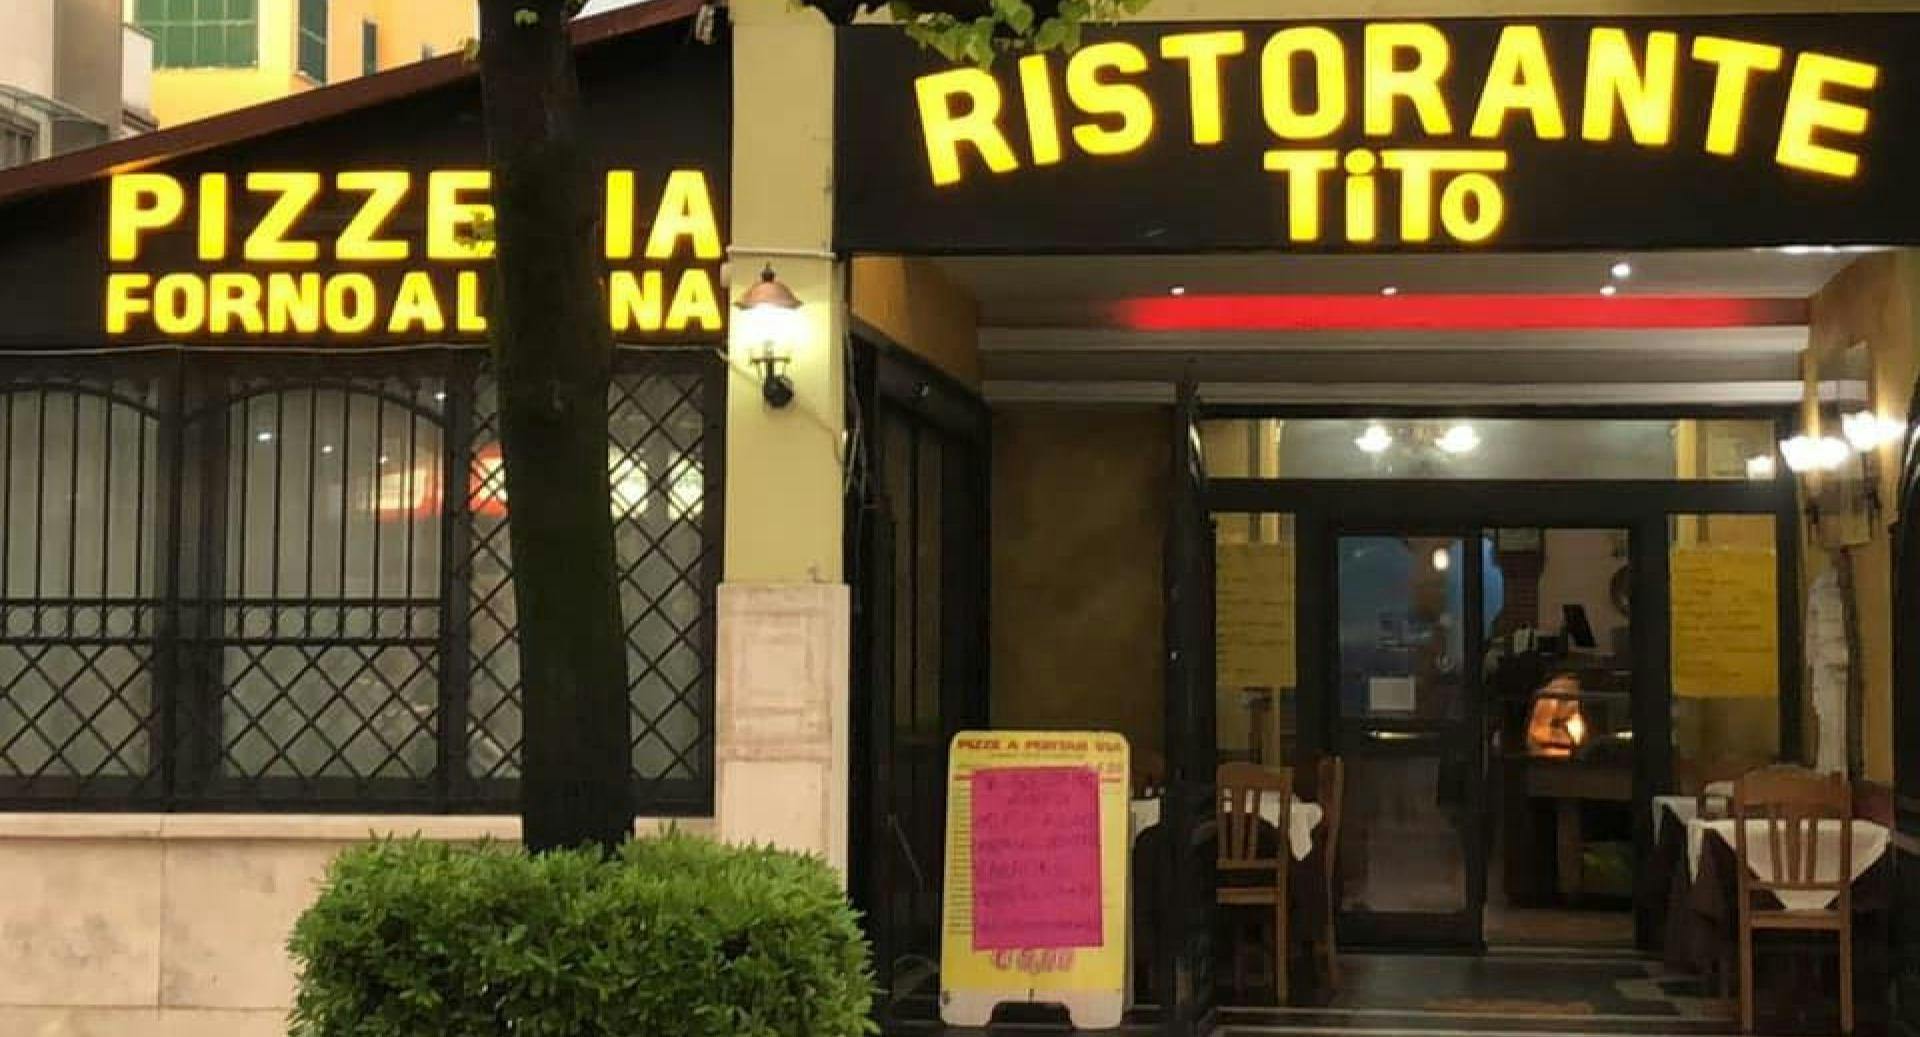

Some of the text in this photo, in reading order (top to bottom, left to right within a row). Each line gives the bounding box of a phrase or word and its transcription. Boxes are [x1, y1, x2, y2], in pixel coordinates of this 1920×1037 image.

[914, 23, 1878, 185] RISTORANTE
[108, 170, 722, 261] PIZZEIA
[107, 269, 723, 333] FORNO A LNA
